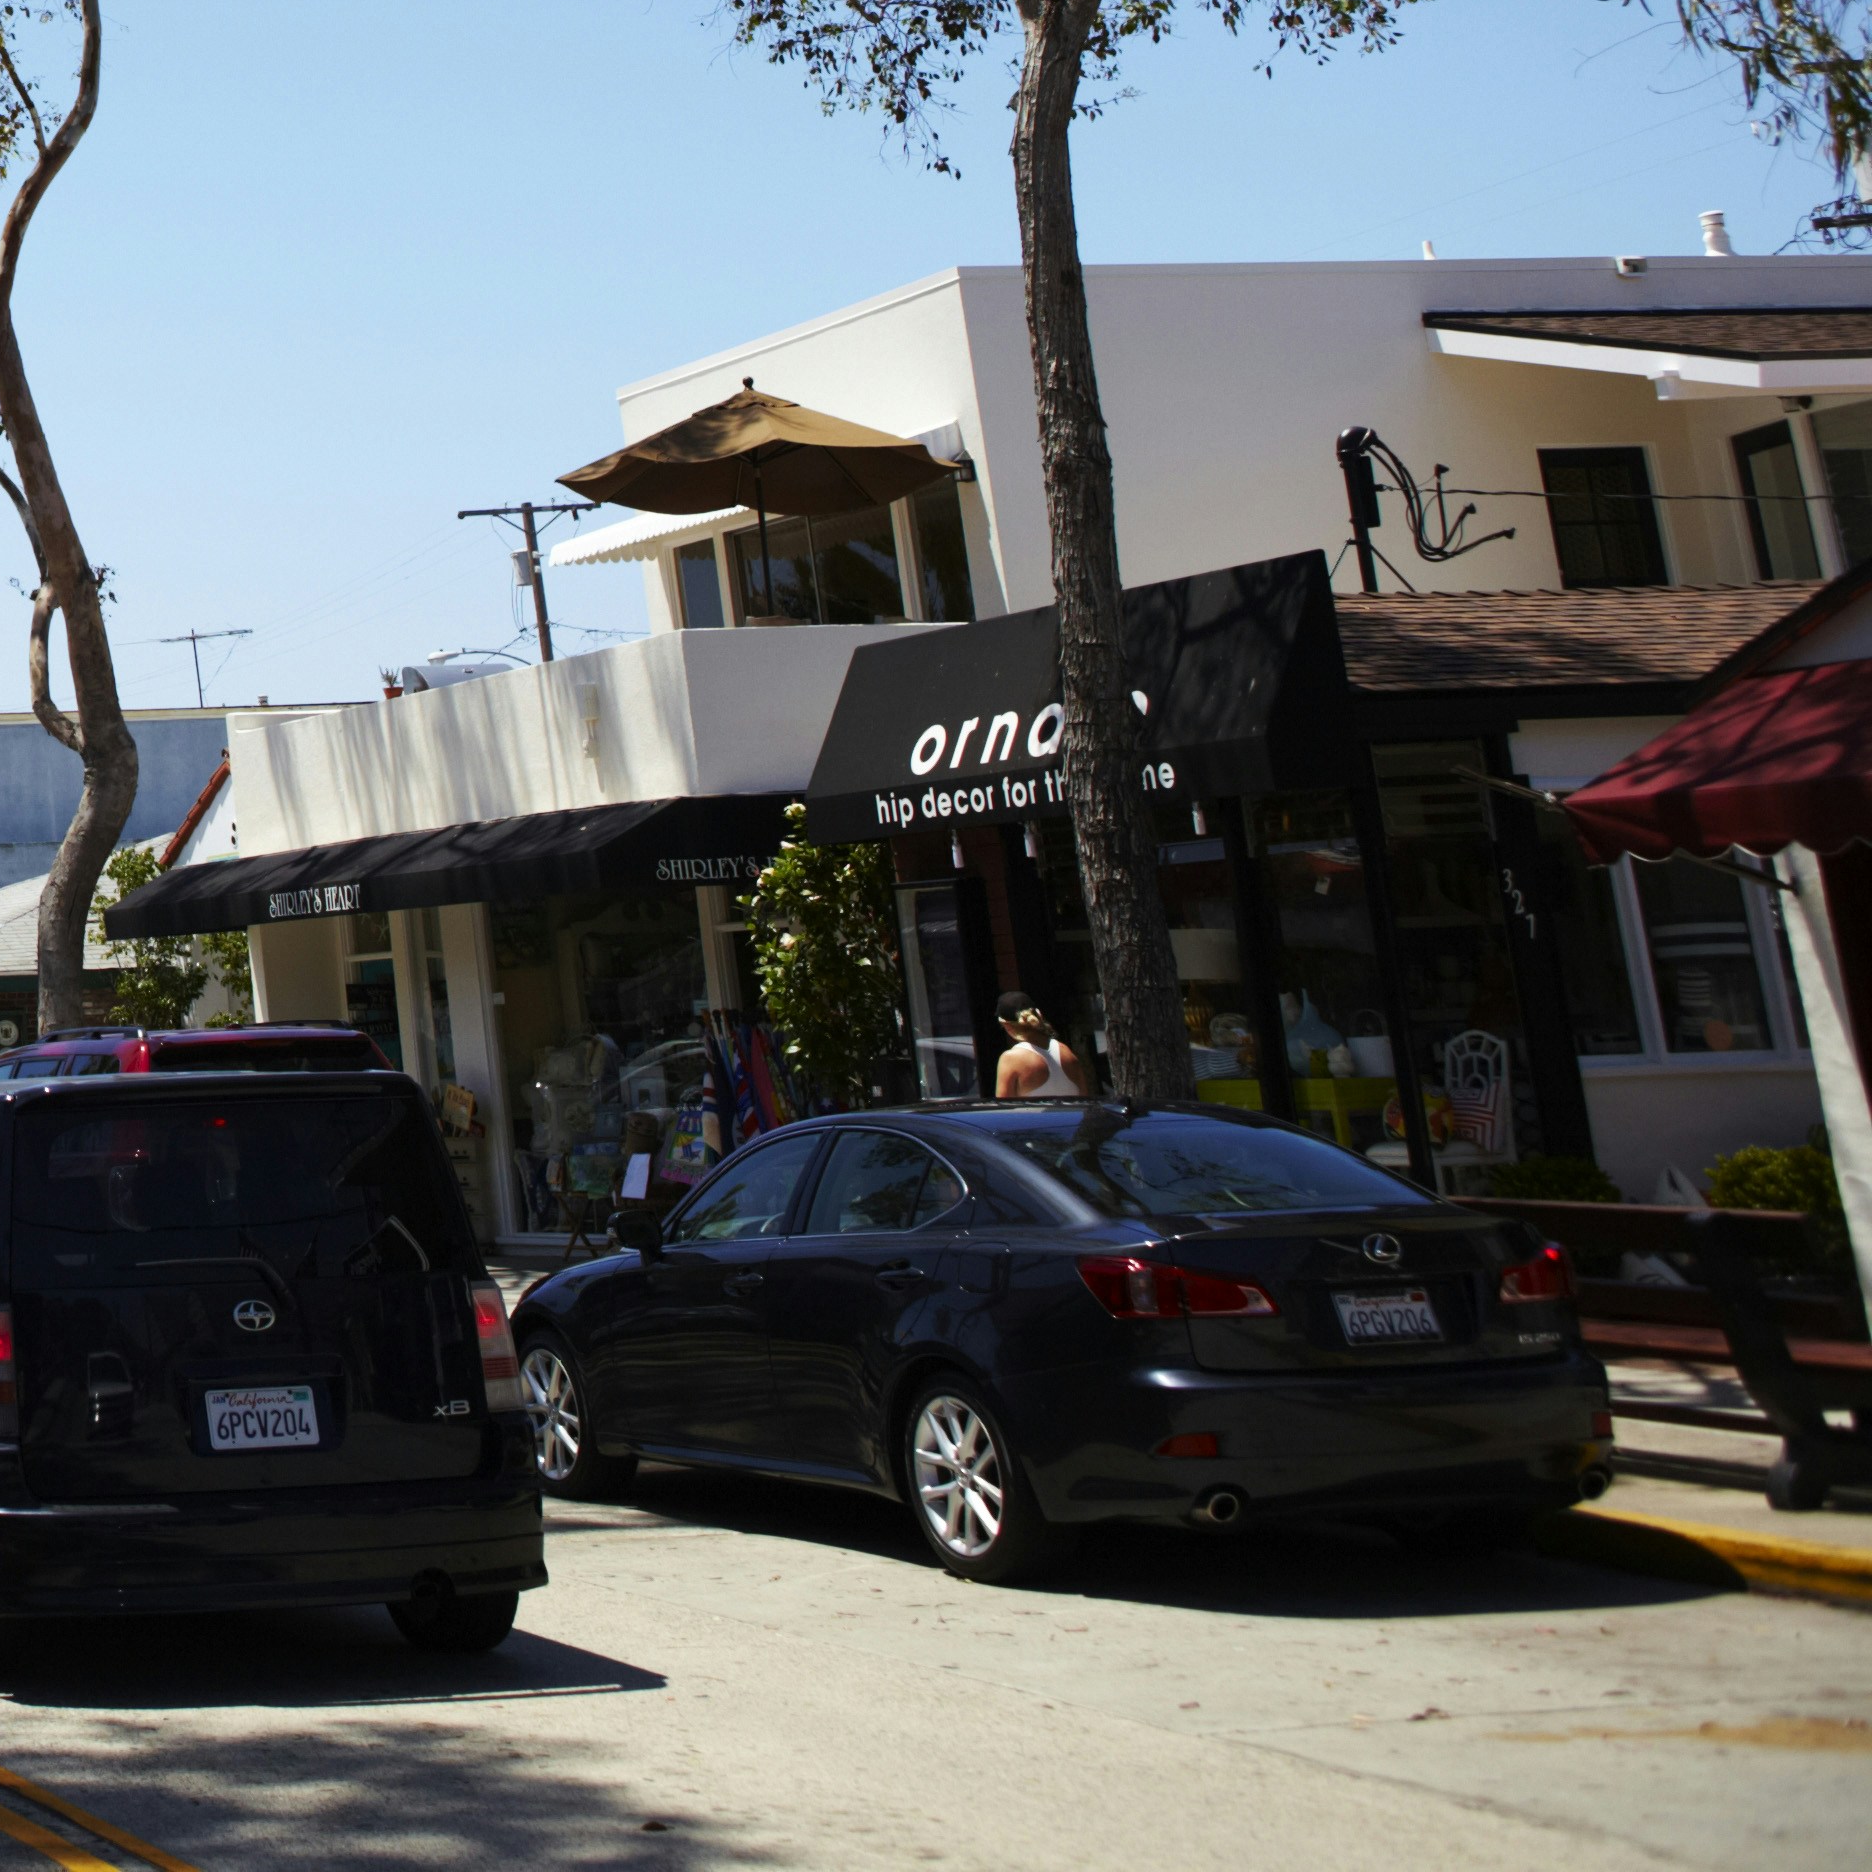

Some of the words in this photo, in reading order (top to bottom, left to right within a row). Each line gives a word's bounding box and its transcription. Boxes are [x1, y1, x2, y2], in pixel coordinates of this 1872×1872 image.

[875, 791, 914, 829] hip
[920, 786, 995, 819] decor
[1001, 775, 1037, 808] for
[1044, 768, 1069, 803] th
[656, 855, 760, 881] SHIRLEY'S
[269, 887, 322, 918] SHIRLEY'S
[324, 883, 361, 912] HEART
[1502, 868, 1535, 940] 321
[1348, 1307, 1433, 1337] 6PGV206
[211, 1395, 226, 1404] JAN
[228, 1391, 294, 1409] California
[432, 1399, 471, 1417] xB
[217, 1408, 311, 1441] 6PCV204
